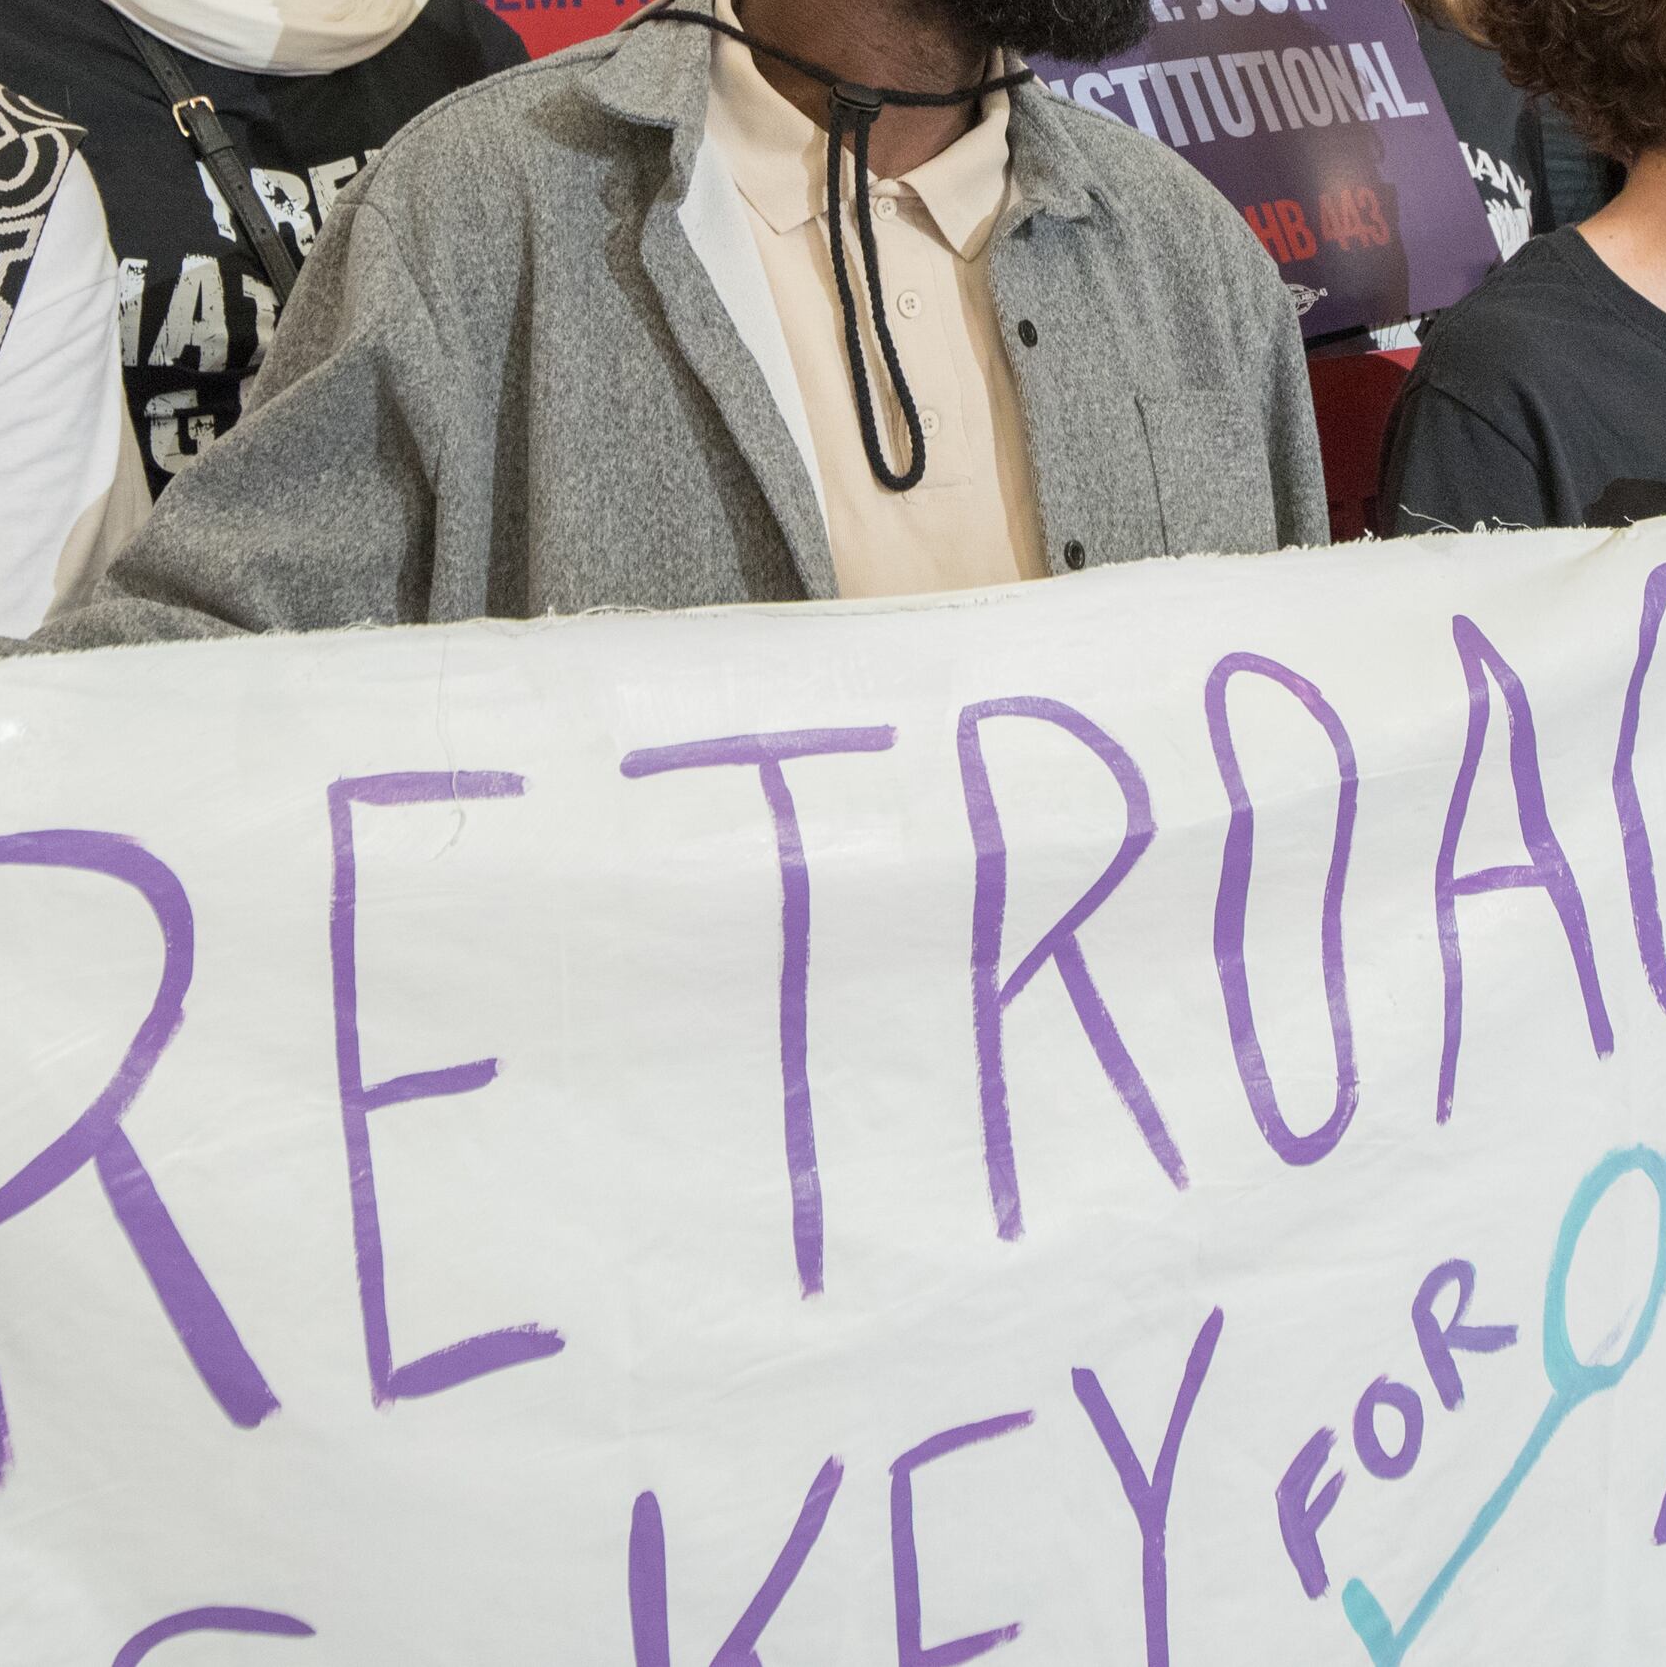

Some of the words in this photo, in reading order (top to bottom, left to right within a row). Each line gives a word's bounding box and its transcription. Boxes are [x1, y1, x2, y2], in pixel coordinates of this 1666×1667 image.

[1048, 41, 1429, 147] STITUTIONAL.
[1244, 199, 1318, 264] HB
[1319, 187, 1390, 251] 443
[1275, 1256, 1519, 1601] FOR
